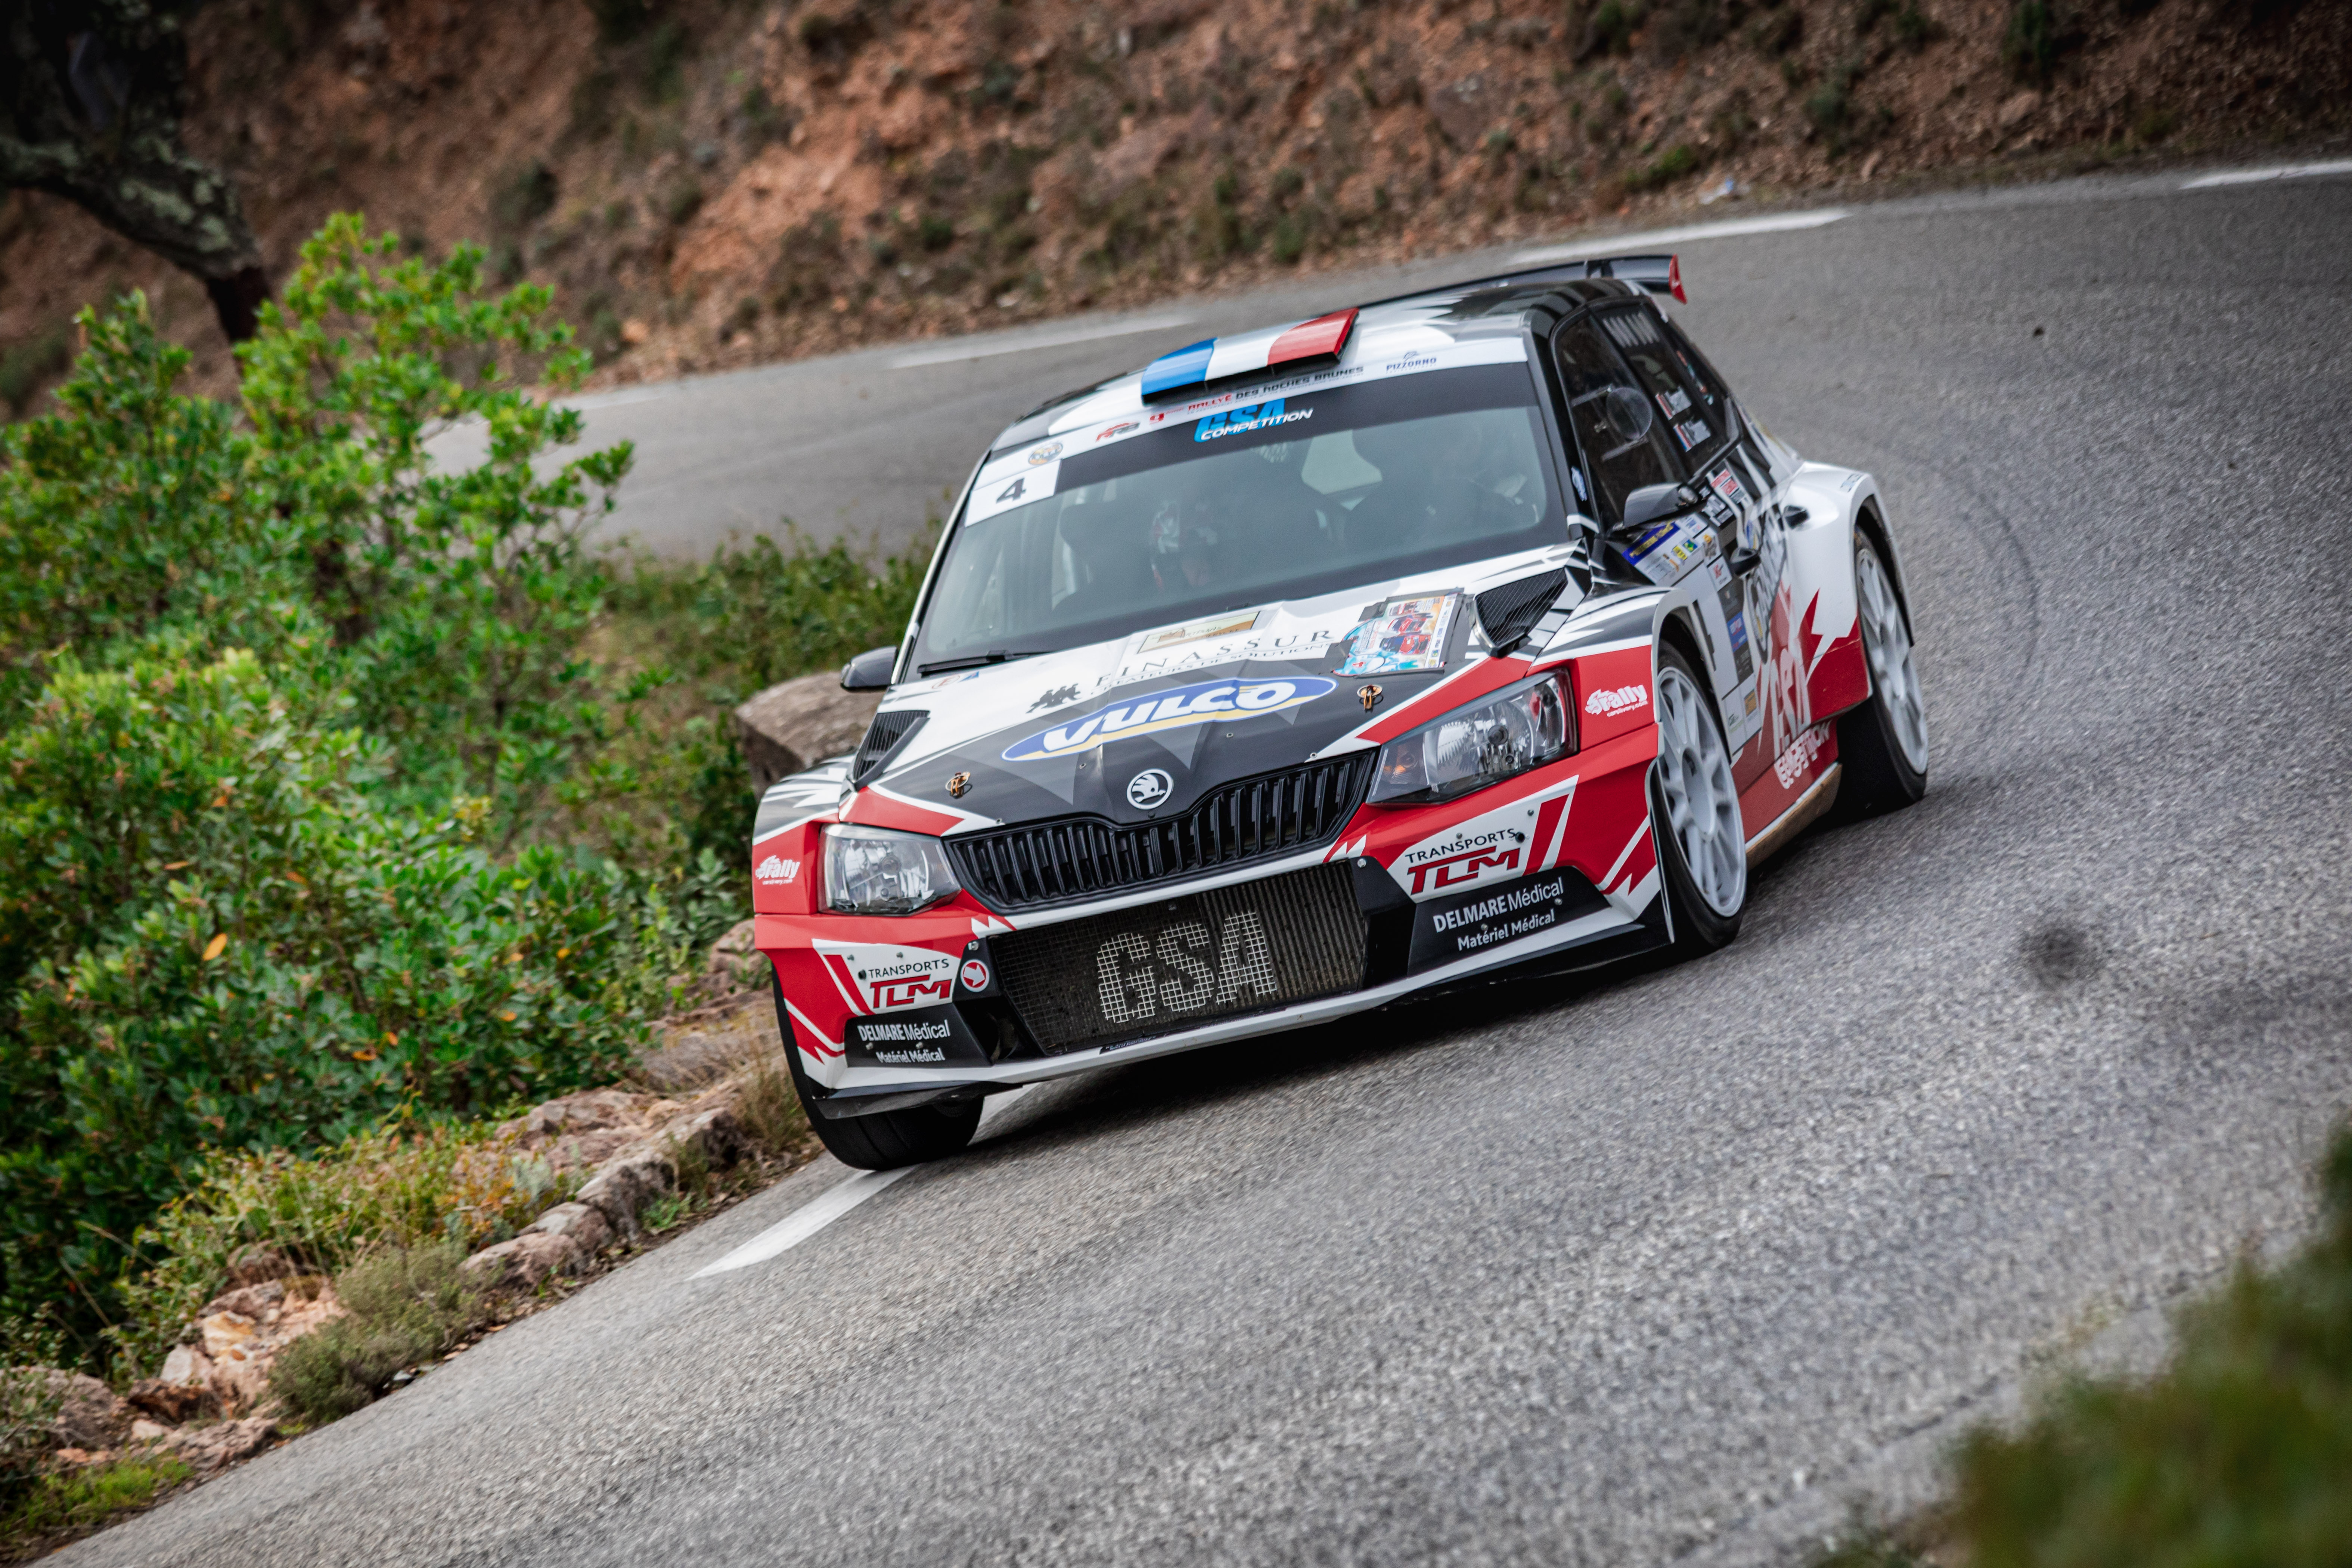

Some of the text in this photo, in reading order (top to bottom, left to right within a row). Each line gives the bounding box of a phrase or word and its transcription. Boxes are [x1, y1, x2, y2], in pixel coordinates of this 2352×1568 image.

[1387, 357, 1437, 371] PIZZORNO
[1188, 393, 1232, 411] RALLYE
[1194, 398, 1285, 443] GSA
[1201, 408, 1314, 440] COMPETITION
[996, 478, 1026, 504] 4
[1096, 630, 1334, 687] FINASSUR
[1043, 682, 1296, 751] VULCO
[1405, 828, 1517, 864] TRANSPORTS
[1433, 877, 1564, 933] DELMARE Médical
[1457, 909, 1555, 951] Matériel Médical
[868, 959, 950, 979] TRANSPORTS
[1097, 911, 1276, 1023] GSA
[857, 1019, 951, 1042] DELMARE Médical
[875, 1047, 946, 1064] Matériel Médical
